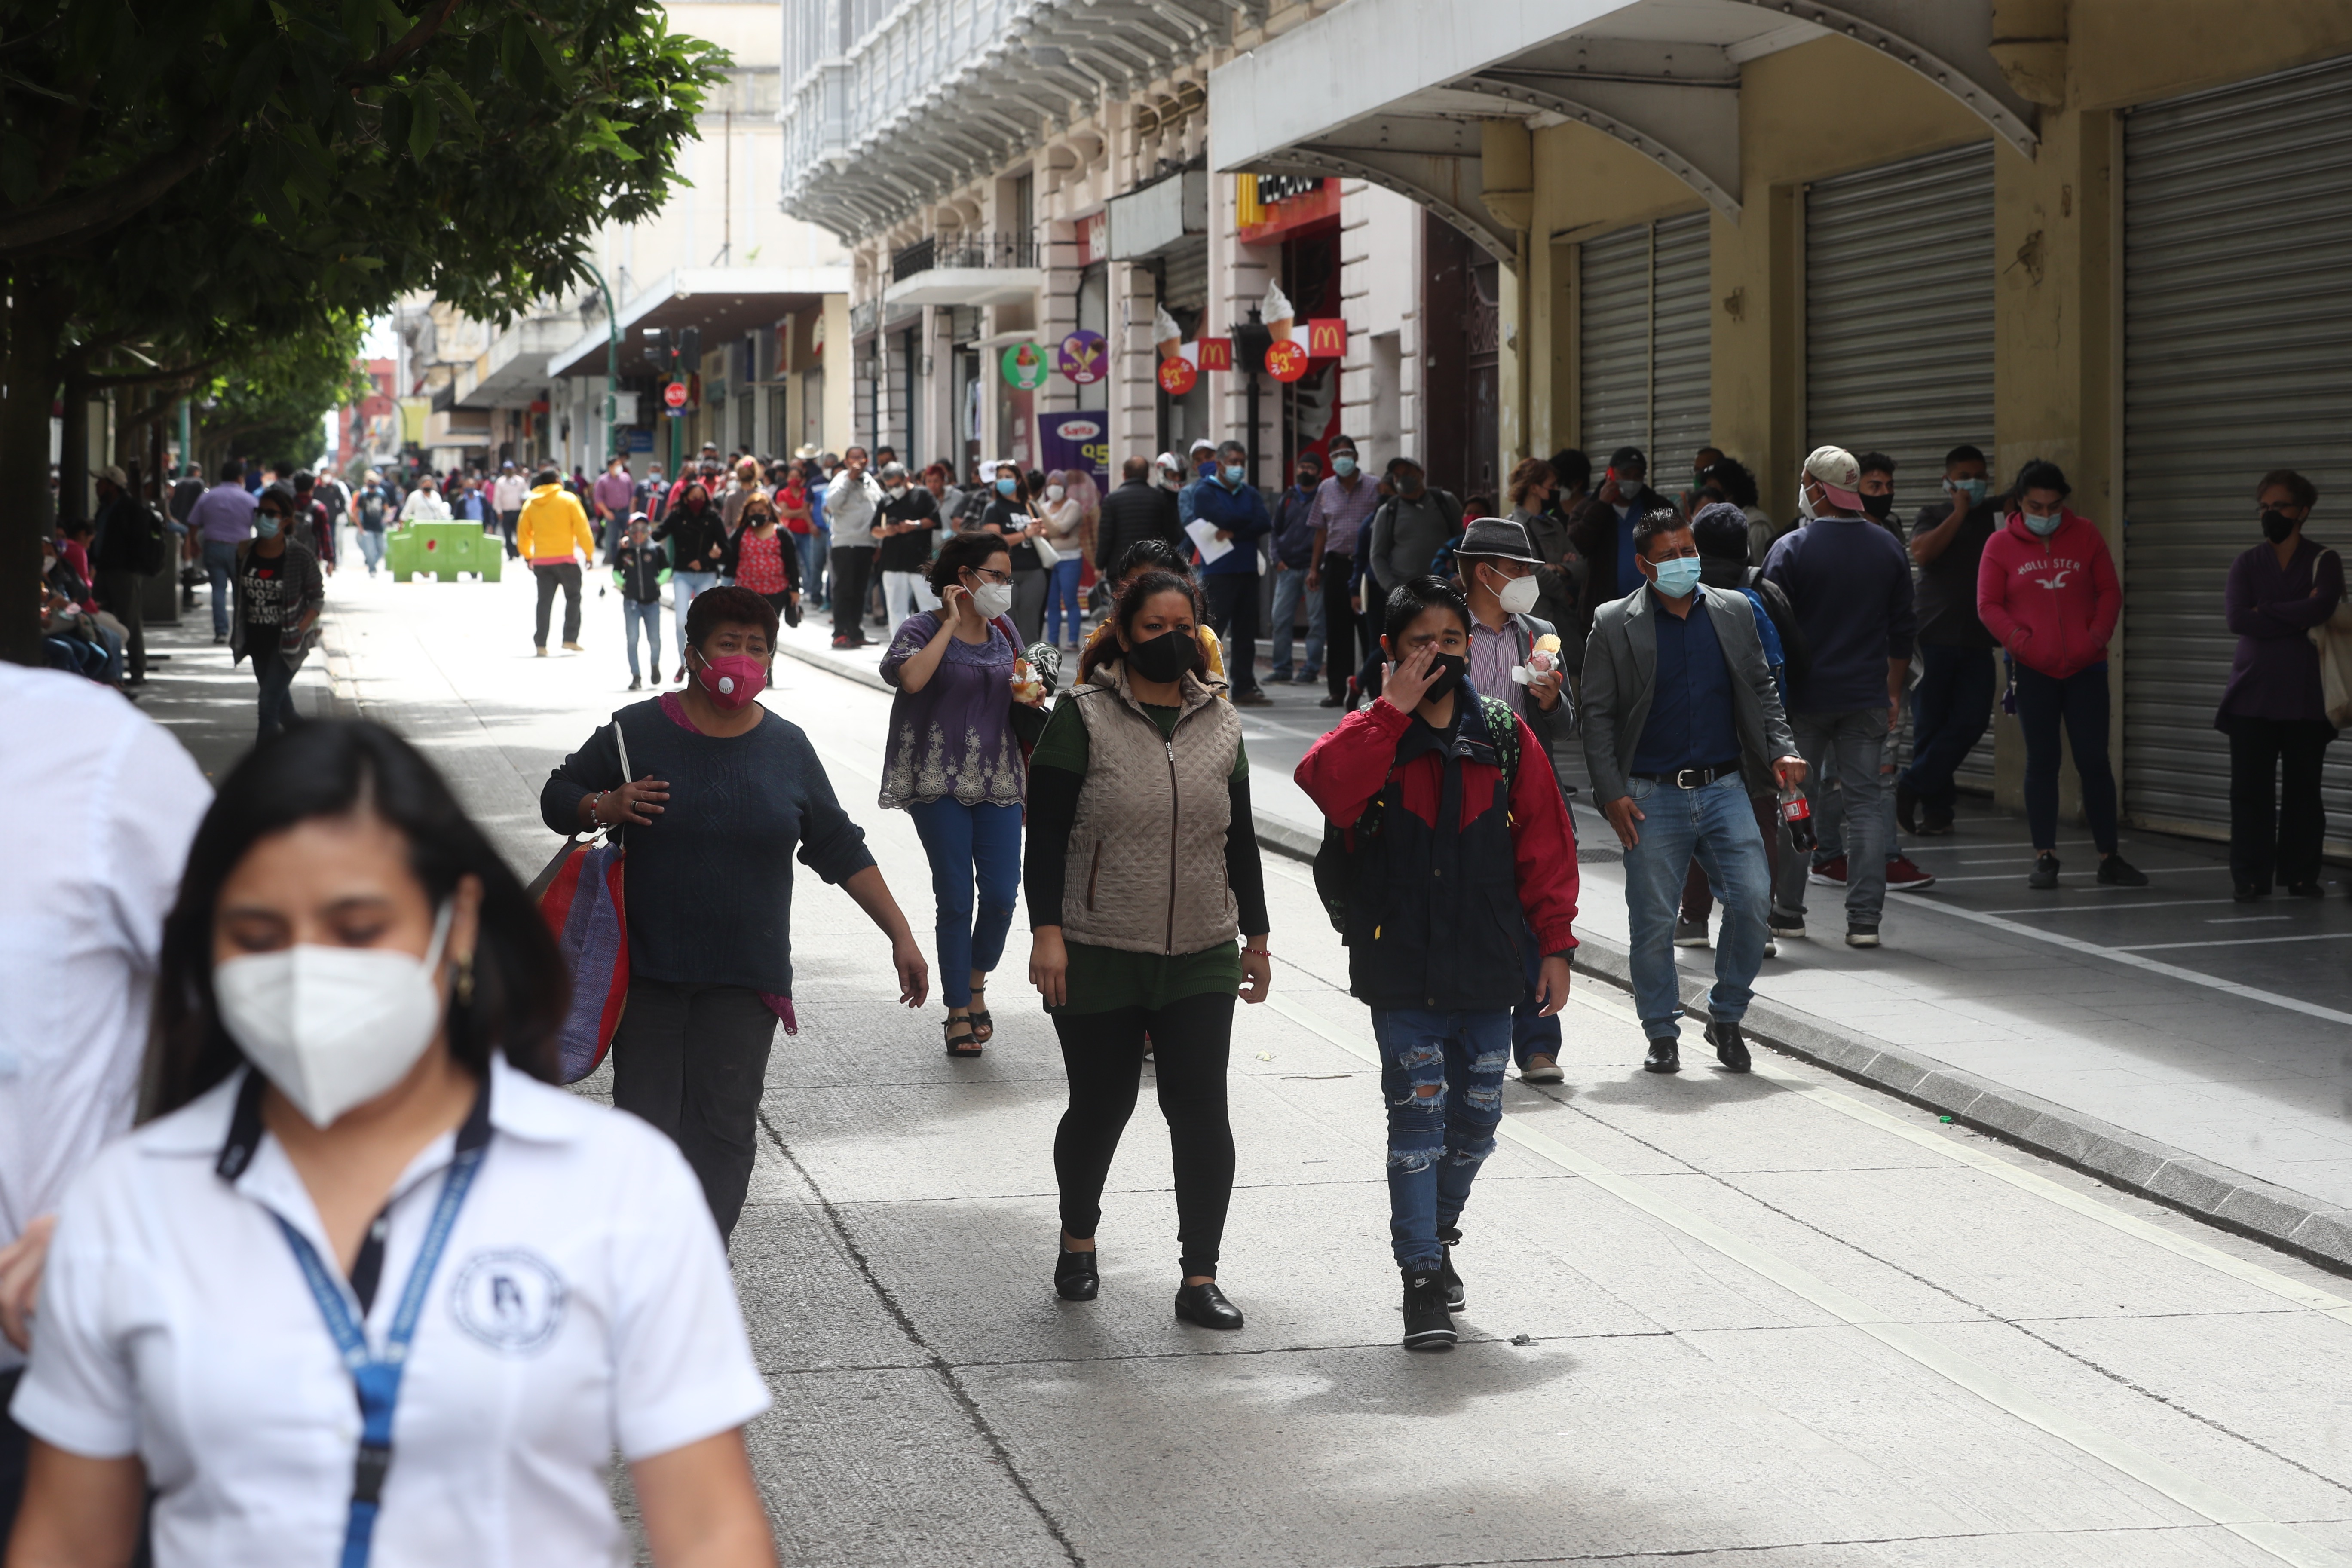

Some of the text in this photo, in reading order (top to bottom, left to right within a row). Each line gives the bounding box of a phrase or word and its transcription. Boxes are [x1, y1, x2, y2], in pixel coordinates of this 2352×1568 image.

[666, 389, 687, 400] ALTO
[1063, 426, 1094, 436] Sarita
[248, 567, 258, 576] I
[2018, 558, 2080, 575] HOLLISTER
[244, 576, 284, 590] HOES
